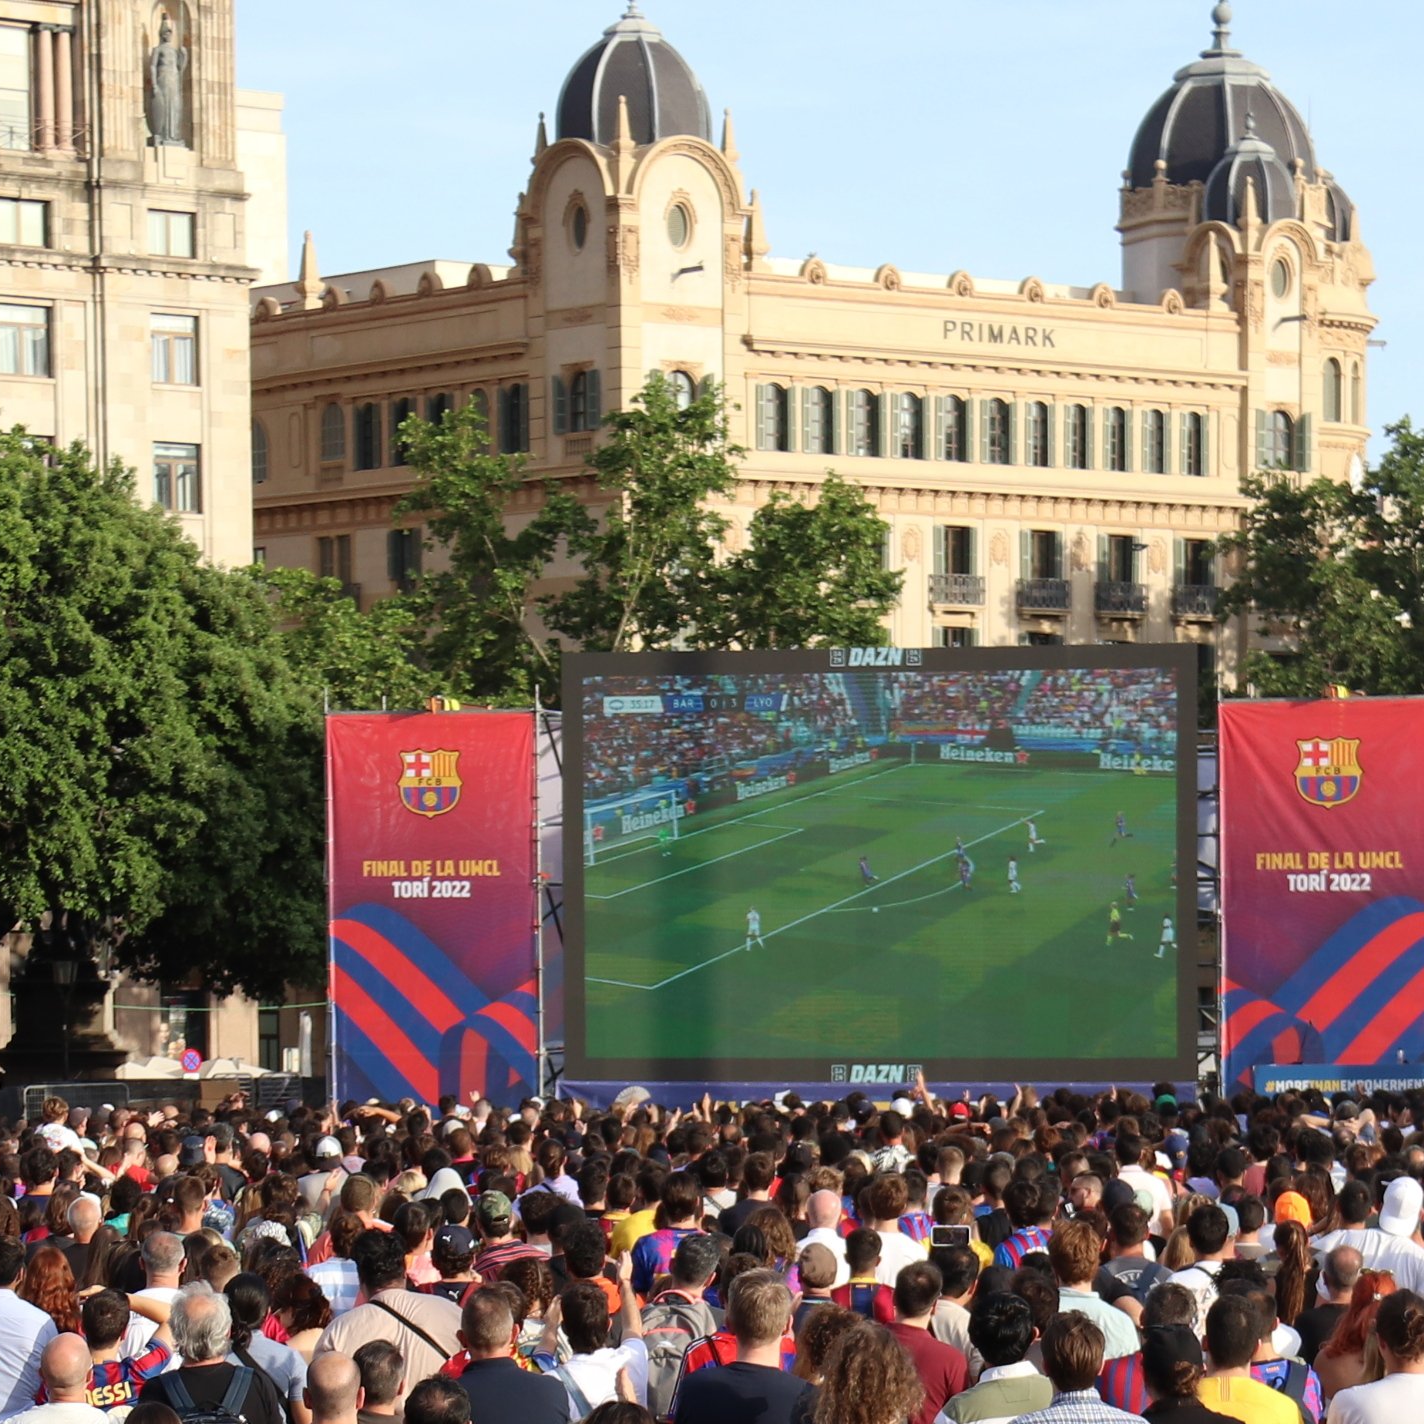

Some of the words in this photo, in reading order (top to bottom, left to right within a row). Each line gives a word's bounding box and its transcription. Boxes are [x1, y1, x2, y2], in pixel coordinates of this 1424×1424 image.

[943, 319, 1056, 348] PRIMARK
[848, 647, 905, 667] DAZN
[673, 697, 694, 708] BAR
[753, 696, 773, 708] LYO
[940, 744, 1016, 763] Heineken
[737, 775, 787, 800] Heineken
[363, 860, 408, 877] FINAL
[411, 860, 432, 876] DE
[436, 860, 455, 876] LA
[459, 859, 501, 876] UWCL
[1256, 852, 1304, 870] FINAL
[1307, 852, 1330, 869] DE
[1334, 852, 1354, 869] LA
[1359, 851, 1404, 869] UWCL
[392, 876, 431, 898] TORÍ
[431, 880, 471, 898] 2022
[1287, 869, 1328, 892] TORÍ
[1329, 872, 1371, 892] 2022
[849, 1064, 905, 1084] DAZN
